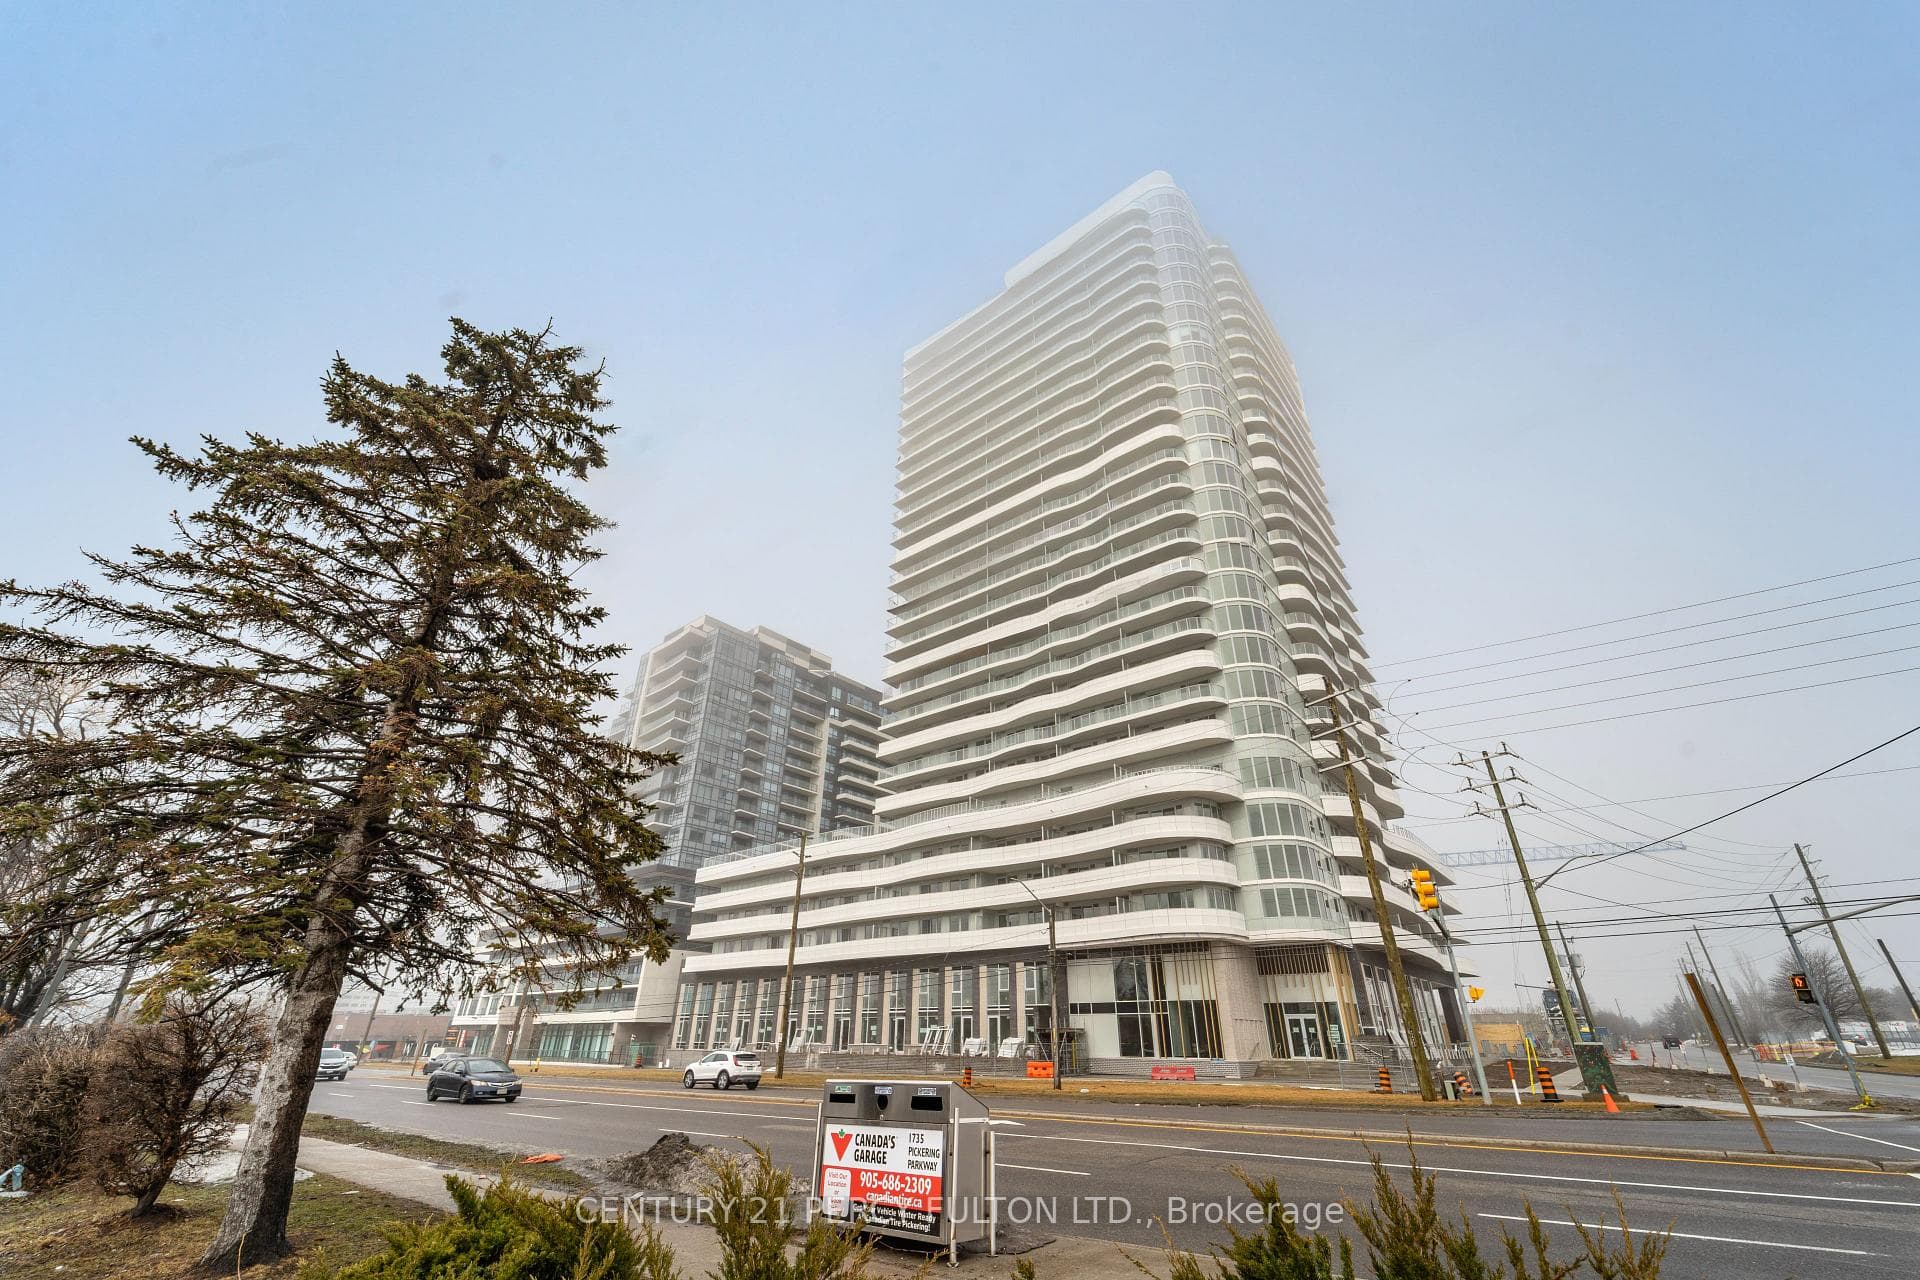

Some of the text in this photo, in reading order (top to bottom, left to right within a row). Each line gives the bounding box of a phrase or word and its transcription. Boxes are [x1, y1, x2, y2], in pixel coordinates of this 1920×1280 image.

[855, 1133, 896, 1149] CANADA'S
[909, 1132, 925, 1144] 1735
[854, 1149, 887, 1165] GARAGE
[908, 1146, 940, 1159] PICKERING
[907, 1159, 938, 1172] PARKWAY
[860, 1171, 932, 1195] 905-686-2309
[866, 1191, 923, 1208] canadiantire.ca
[877, 1206, 897, 1217] Vehicle
[898, 1210, 917, 1220] Winter
[917, 1212, 936, 1224] Ready
[890, 1218, 902, 1227] Tire
[902, 1220, 931, 1233] Pickering!
